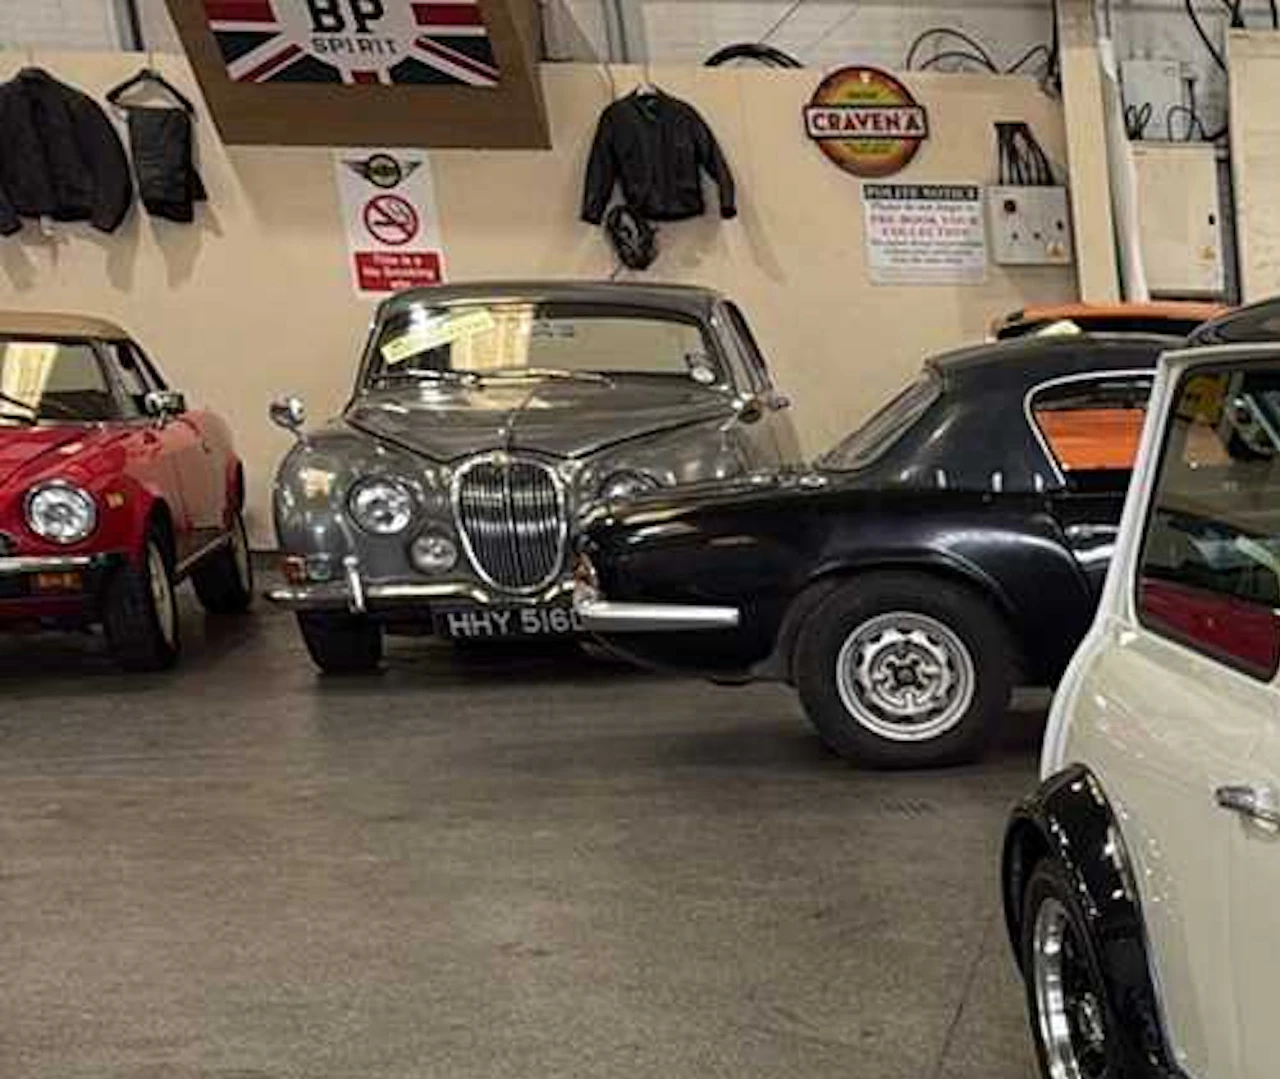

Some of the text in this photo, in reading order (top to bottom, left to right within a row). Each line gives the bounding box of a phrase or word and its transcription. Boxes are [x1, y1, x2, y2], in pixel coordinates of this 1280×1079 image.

[308, 0, 384, 32] BP
[310, 38, 398, 55] SPIRIT
[813, 112, 902, 131] CRAVEN
[446, 610, 511, 637] HHY
